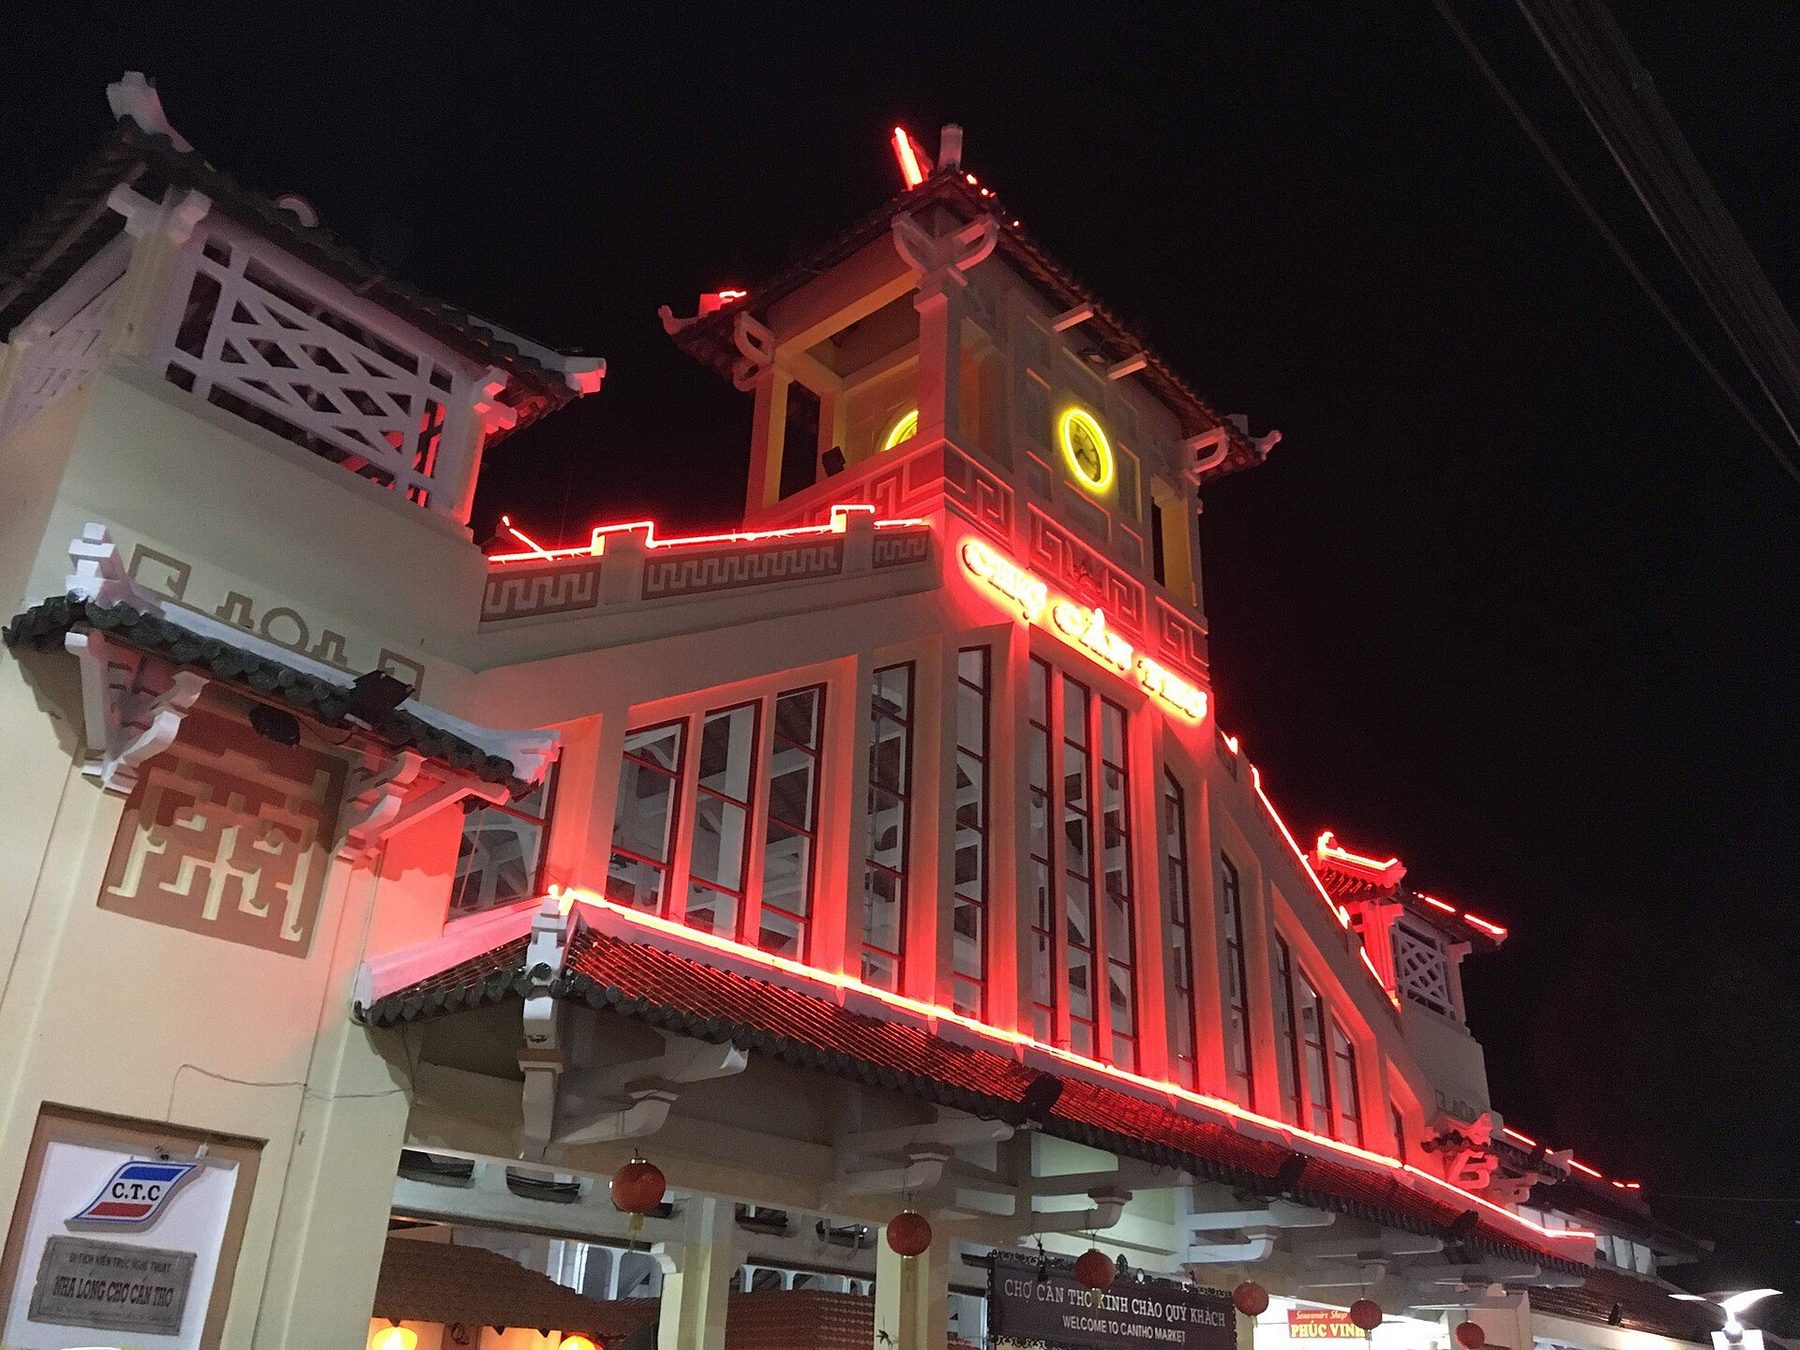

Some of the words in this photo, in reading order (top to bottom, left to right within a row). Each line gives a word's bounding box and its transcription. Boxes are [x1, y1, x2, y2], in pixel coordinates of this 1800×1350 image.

[112, 1182, 160, 1201] C.T.C
[1004, 1279, 1032, 1303] CHỢ
[1036, 1280, 1064, 1303] CẦN
[1097, 1289, 1128, 1312] KÍNH
[1131, 1297, 1162, 1318] CHÀO
[1165, 1302, 1187, 1322] QUÝ
[1190, 1306, 1226, 1327] KHÁCH
[1330, 1310, 1348, 1321] Shop
[1062, 1315, 1107, 1333] WELCOME
[1108, 1321, 1119, 1334] TO
[1120, 1322, 1153, 1339] CANTHO
[1154, 1327, 1185, 1343] MARKET
[1291, 1320, 1327, 1338] PHÚC
